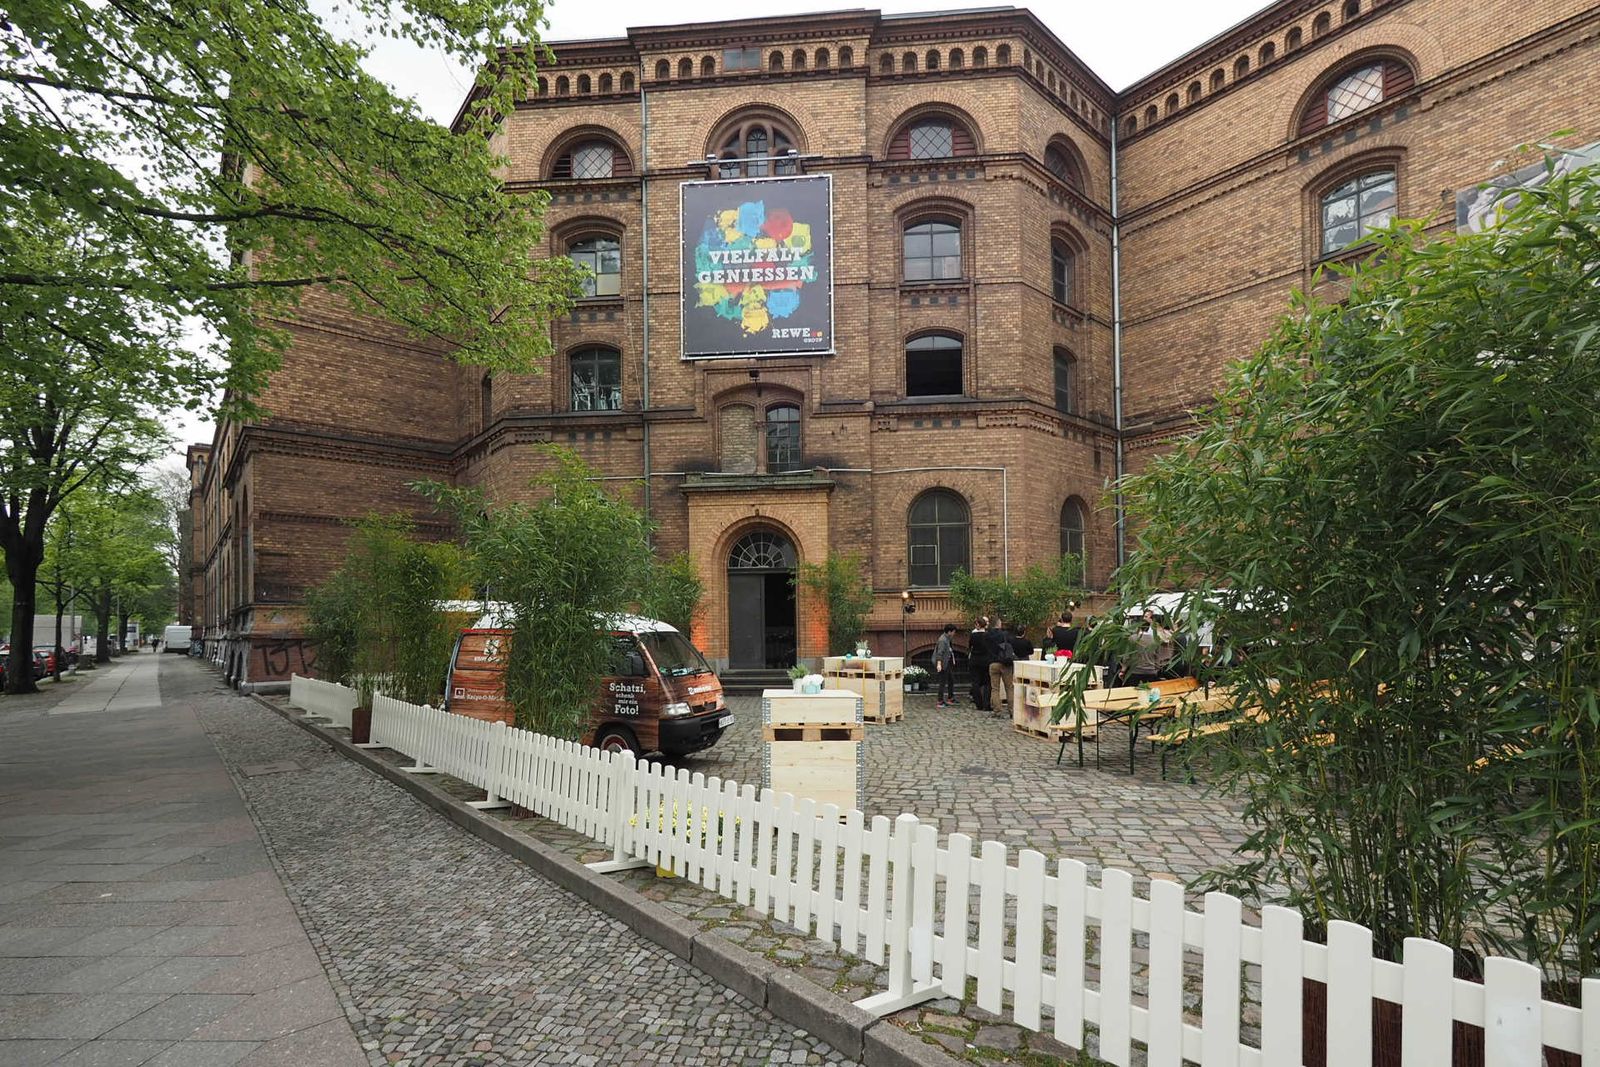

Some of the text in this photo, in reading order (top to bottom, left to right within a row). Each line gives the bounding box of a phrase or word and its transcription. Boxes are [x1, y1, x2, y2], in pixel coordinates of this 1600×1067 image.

[709, 247, 803, 264] VIELFALT
[698, 266, 815, 284] GENIESSEN
[771, 327, 811, 338] REWE
[609, 682, 647, 694] Schatzi,
[614, 704, 639, 715] Foto!
